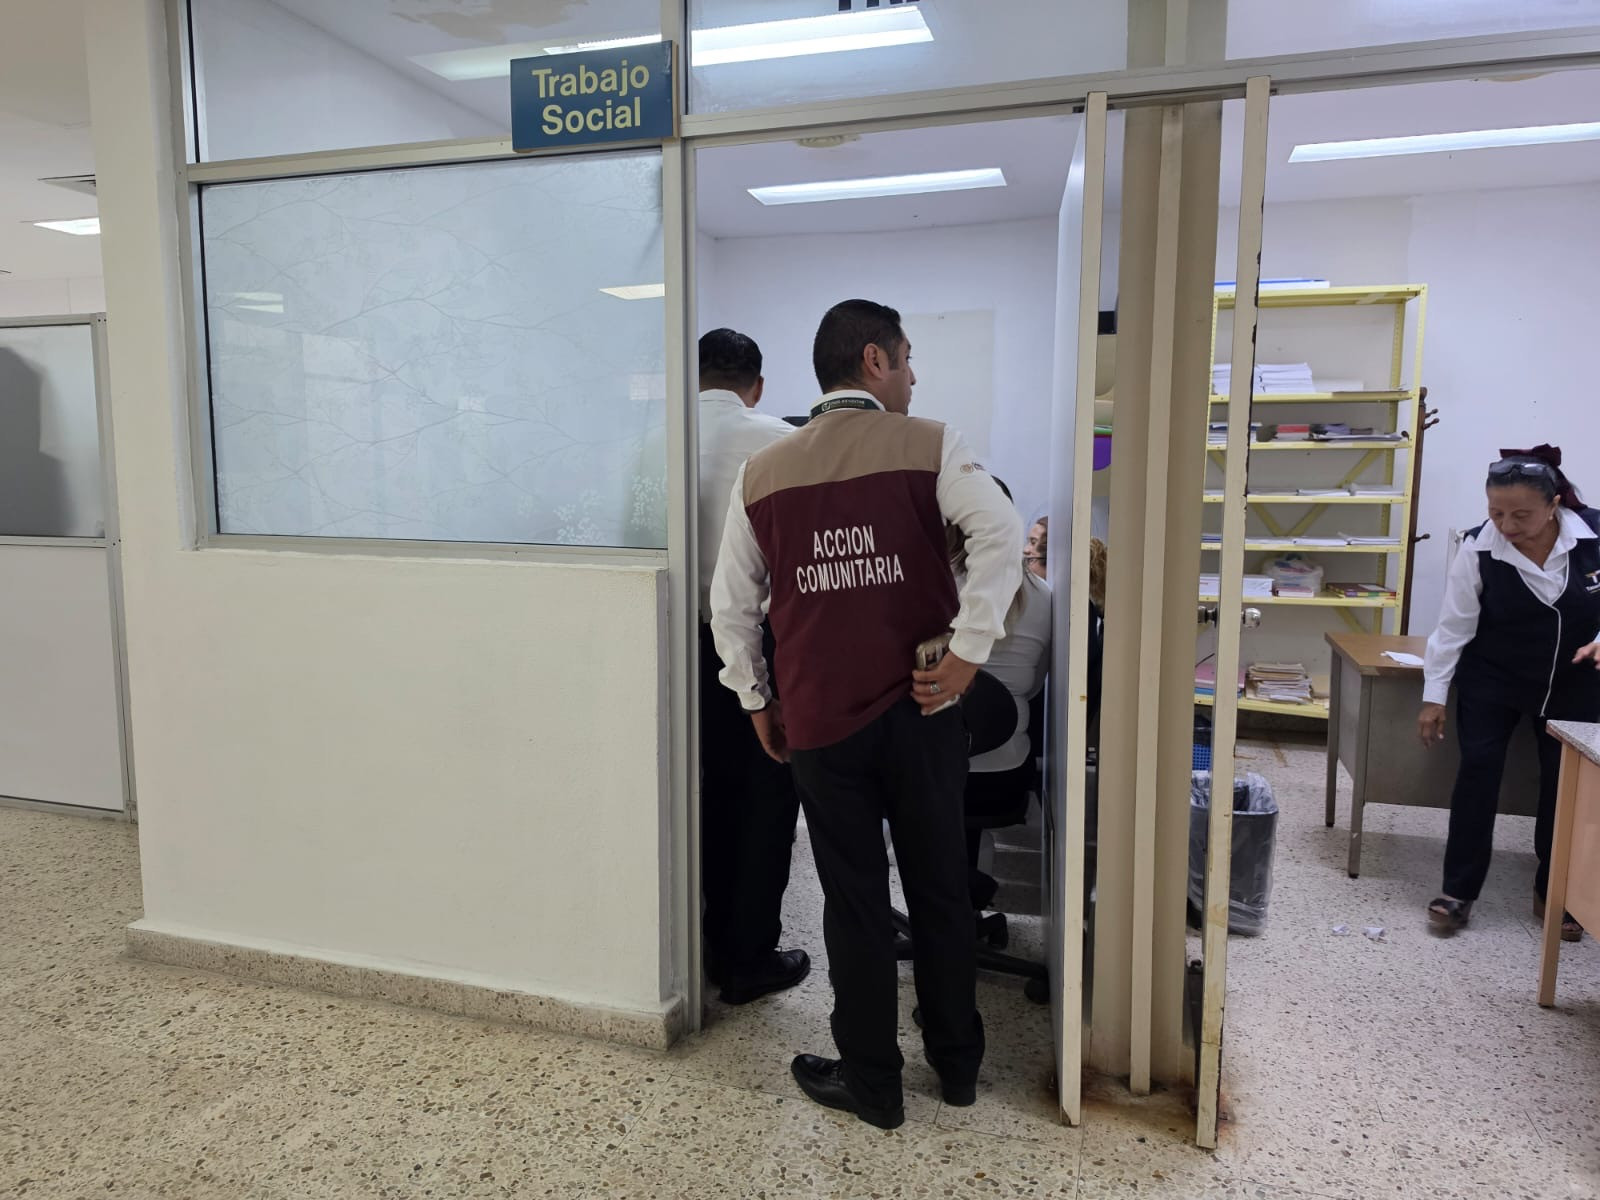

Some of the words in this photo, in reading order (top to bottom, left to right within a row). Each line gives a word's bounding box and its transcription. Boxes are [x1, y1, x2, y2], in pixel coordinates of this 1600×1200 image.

[531, 59, 650, 99] Trabajo
[541, 96, 641, 135] Social
[813, 524, 875, 560] ACCION
[796, 553, 905, 594] COMUNITARIA
